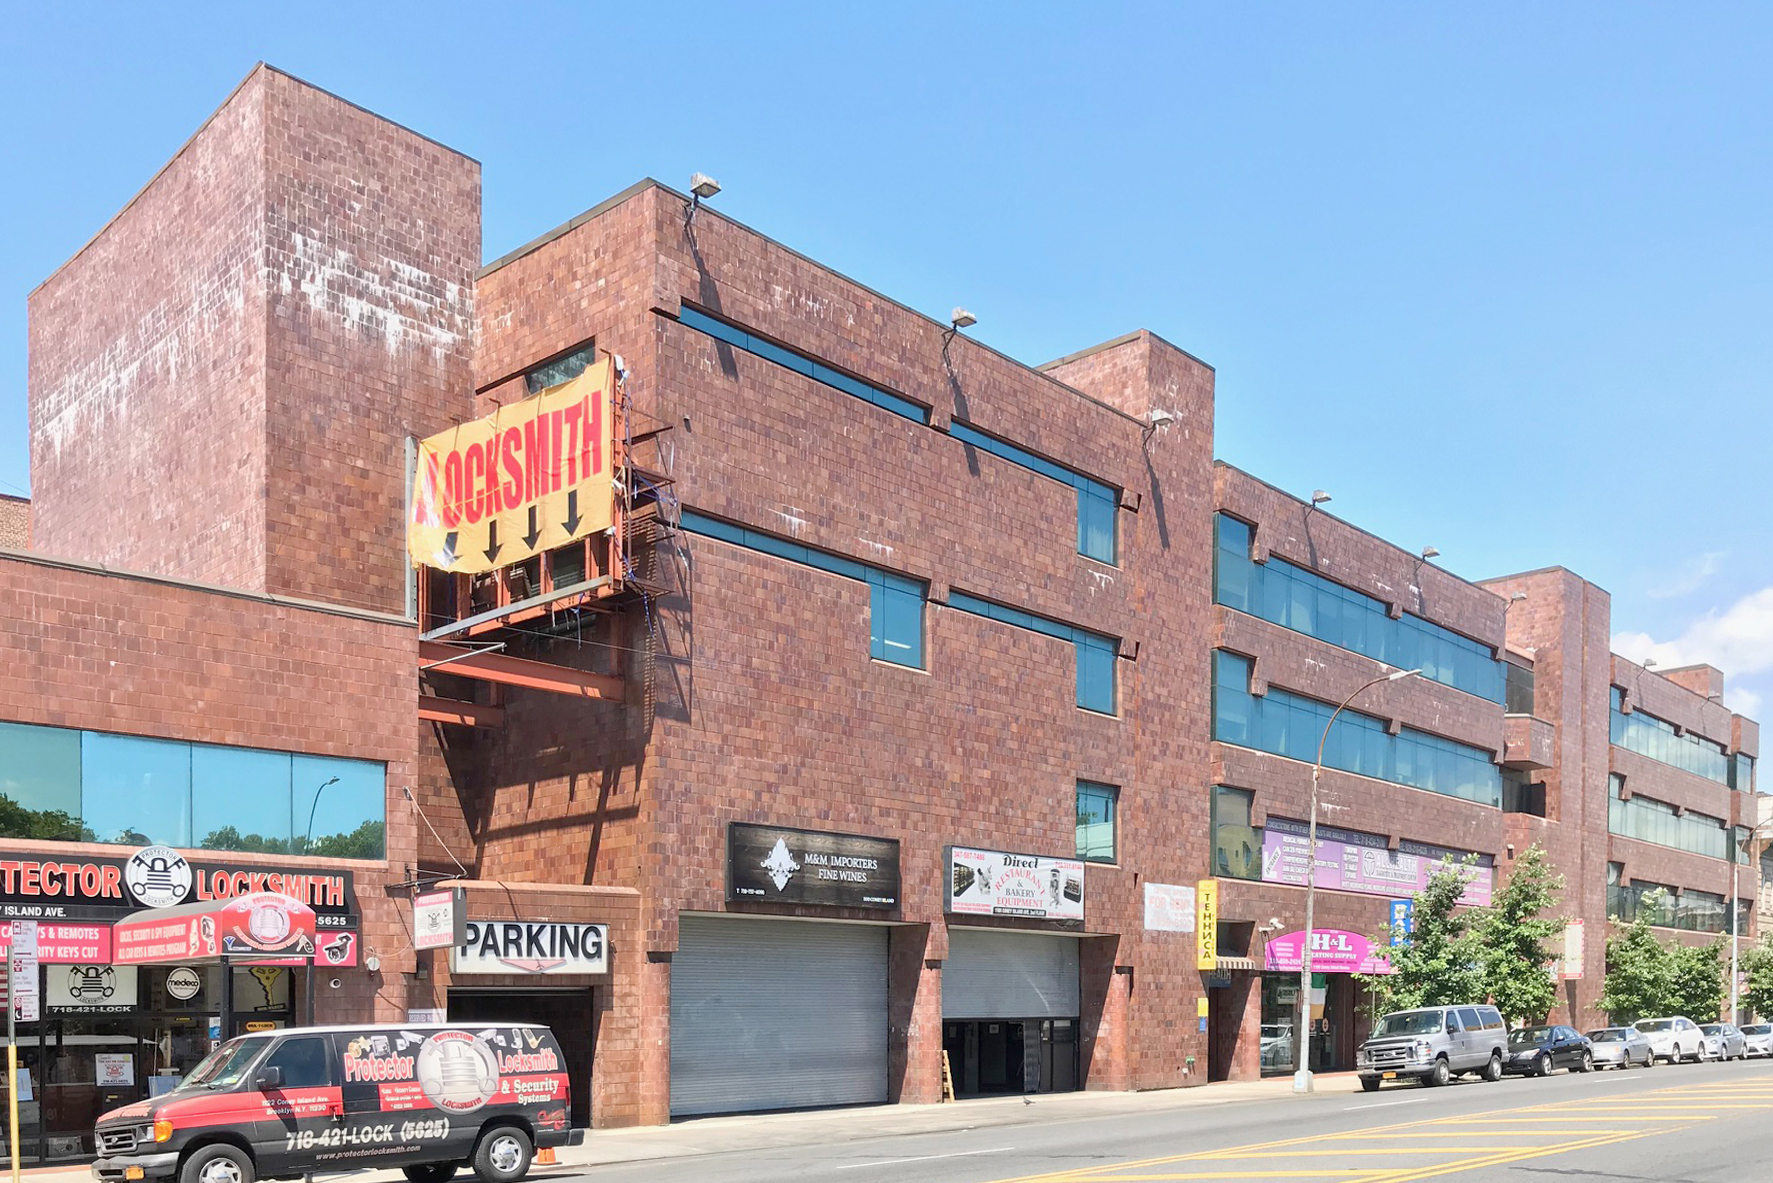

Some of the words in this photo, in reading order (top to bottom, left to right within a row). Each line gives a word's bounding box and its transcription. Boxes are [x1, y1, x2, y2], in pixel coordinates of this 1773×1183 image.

[141, 849, 178, 860] PROTECTOR
[804, 853, 828, 865] M&M
[830, 855, 878, 870] IMPORTERS
[1003, 854, 1039, 869] Direct
[818, 868, 839, 881] FINE
[839, 870, 868, 883] WINES
[995, 868, 1045, 895] RESTAURANT
[196, 869, 344, 906] LOCKSMITH
[1016, 879, 1024, 888] &
[1005, 888, 1036, 898] BAKERY
[996, 897, 1044, 908] EQUIPMENT
[4, 906, 43, 917] ISLAND
[45, 908, 67, 918] AVE.
[49, 928, 56, 939] &
[58, 929, 100, 940] REMOTES
[461, 923, 603, 959] PARKING
[1311, 933, 1353, 951] H&L
[57, 946, 79, 958] KEYS
[81, 947, 99, 959] CUT
[168, 978, 198, 987] medeco
[433, 1032, 474, 1043] PROTECTOR
[343, 1051, 414, 1082] Protector
[497, 1047, 559, 1073] Locksmith
[501, 1082, 511, 1094] &
[514, 1077, 560, 1094] Security
[441, 1096, 482, 1109] LOCKSMITH
[517, 1094, 551, 1106] Systems
[286, 1124, 395, 1151] 718-421-LOCK
[400, 1117, 450, 1142] (5625)
[316, 1144, 421, 1160] www.protectorlocksmith.com
